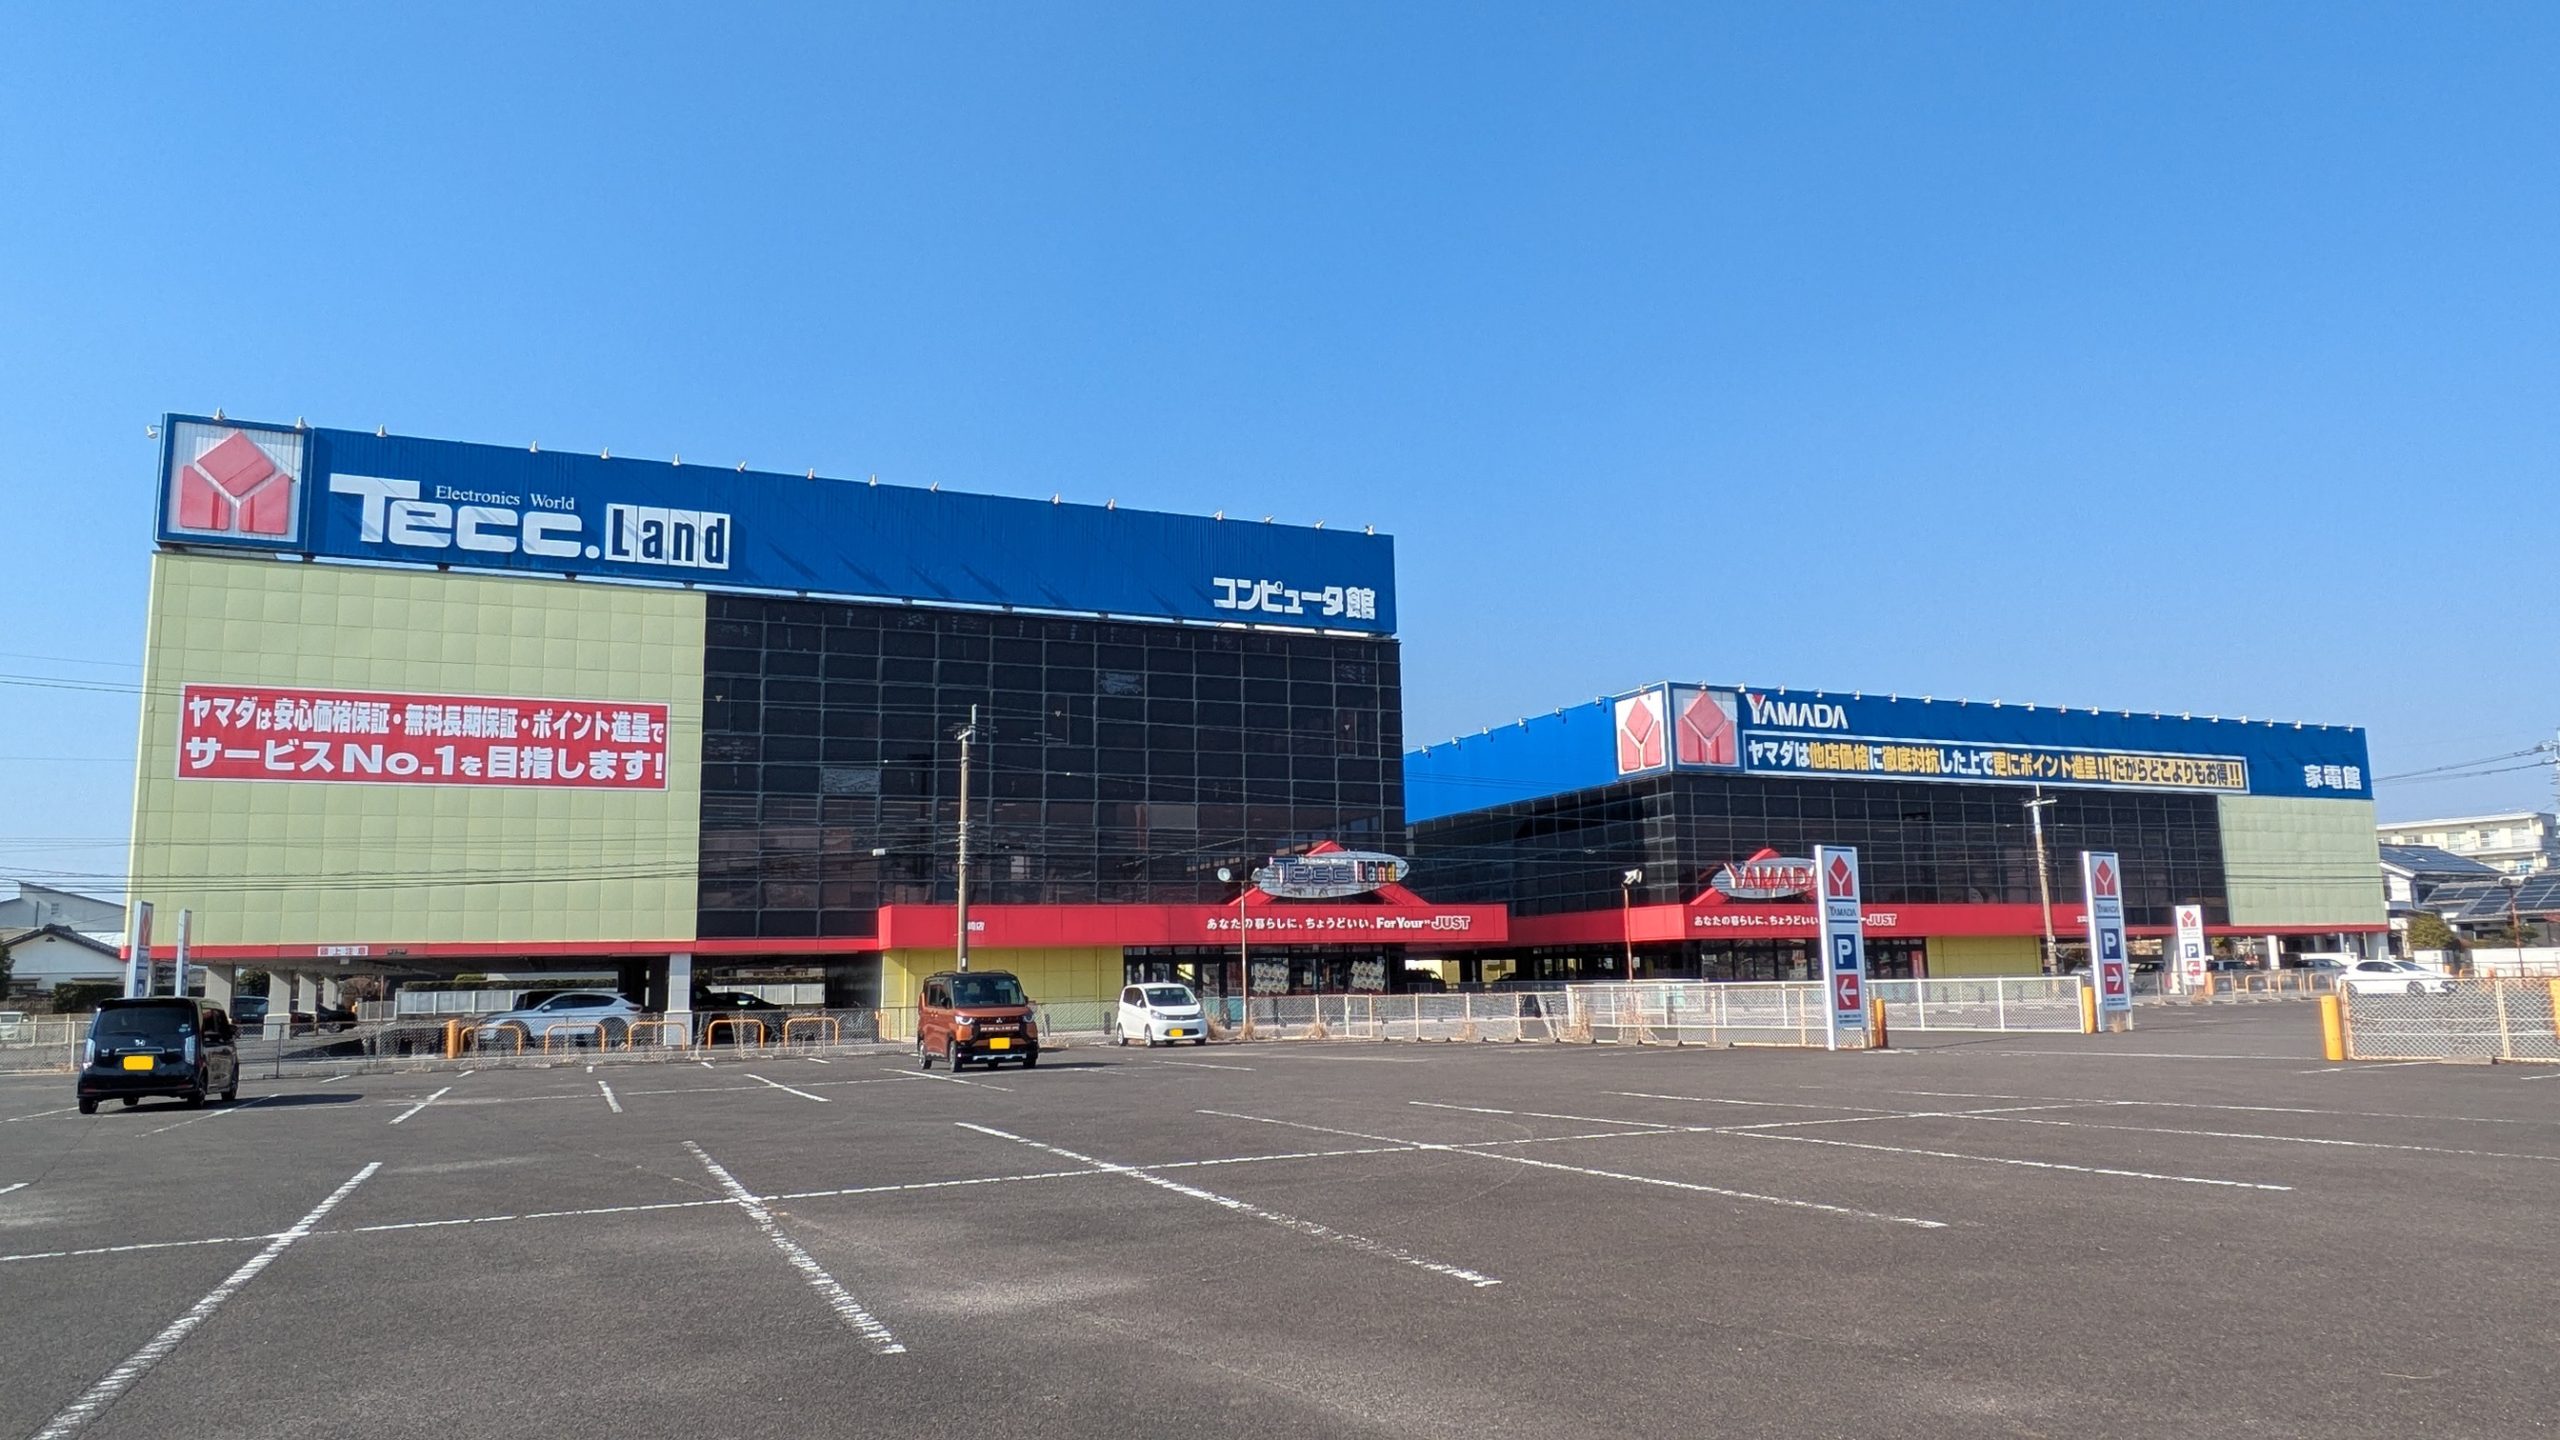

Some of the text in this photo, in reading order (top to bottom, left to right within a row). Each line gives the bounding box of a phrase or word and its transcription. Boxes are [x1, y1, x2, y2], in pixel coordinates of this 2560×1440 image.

[436, 485, 576, 511] Electronics World
[605, 503, 730, 570] Land
[1213, 577, 1376, 620] コンピュータ館
[1745, 693, 1849, 730] YAMADA
[2304, 764, 2362, 790] 家電館
[1358, 861, 1397, 883] Land
[1430, 915, 1471, 930] JUST
[1828, 905, 1857, 917] YAMADA
[1866, 914, 1897, 927] JUST
[1838, 938, 1853, 965] P
[2104, 932, 2117, 955] P
[2187, 945, 2197, 958] P
